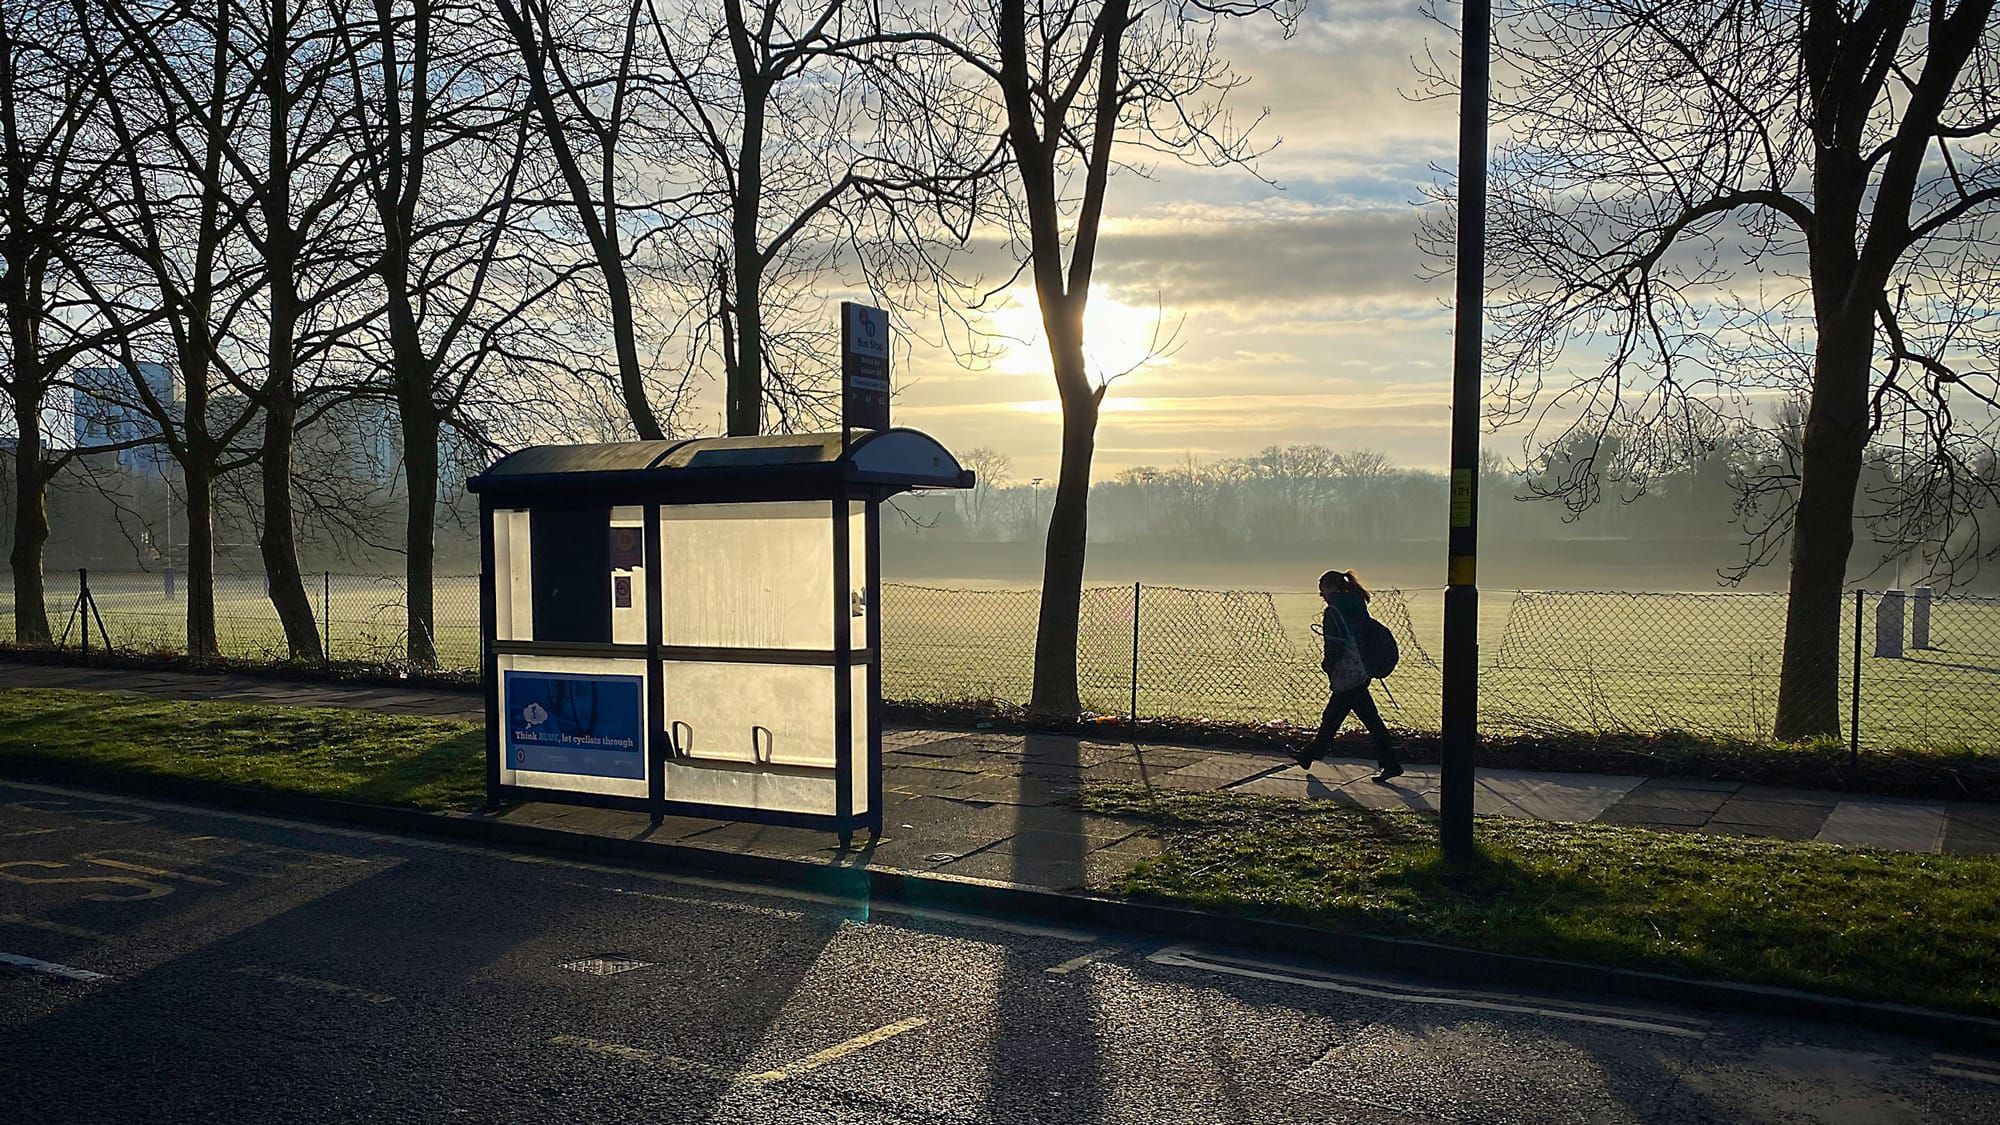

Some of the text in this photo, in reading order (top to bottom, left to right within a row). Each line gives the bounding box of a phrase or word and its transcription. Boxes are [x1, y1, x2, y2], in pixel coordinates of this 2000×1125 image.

[857, 336, 884, 353] Bus Stop
[514, 731, 634, 748] Think BLUE, let cyclists through
